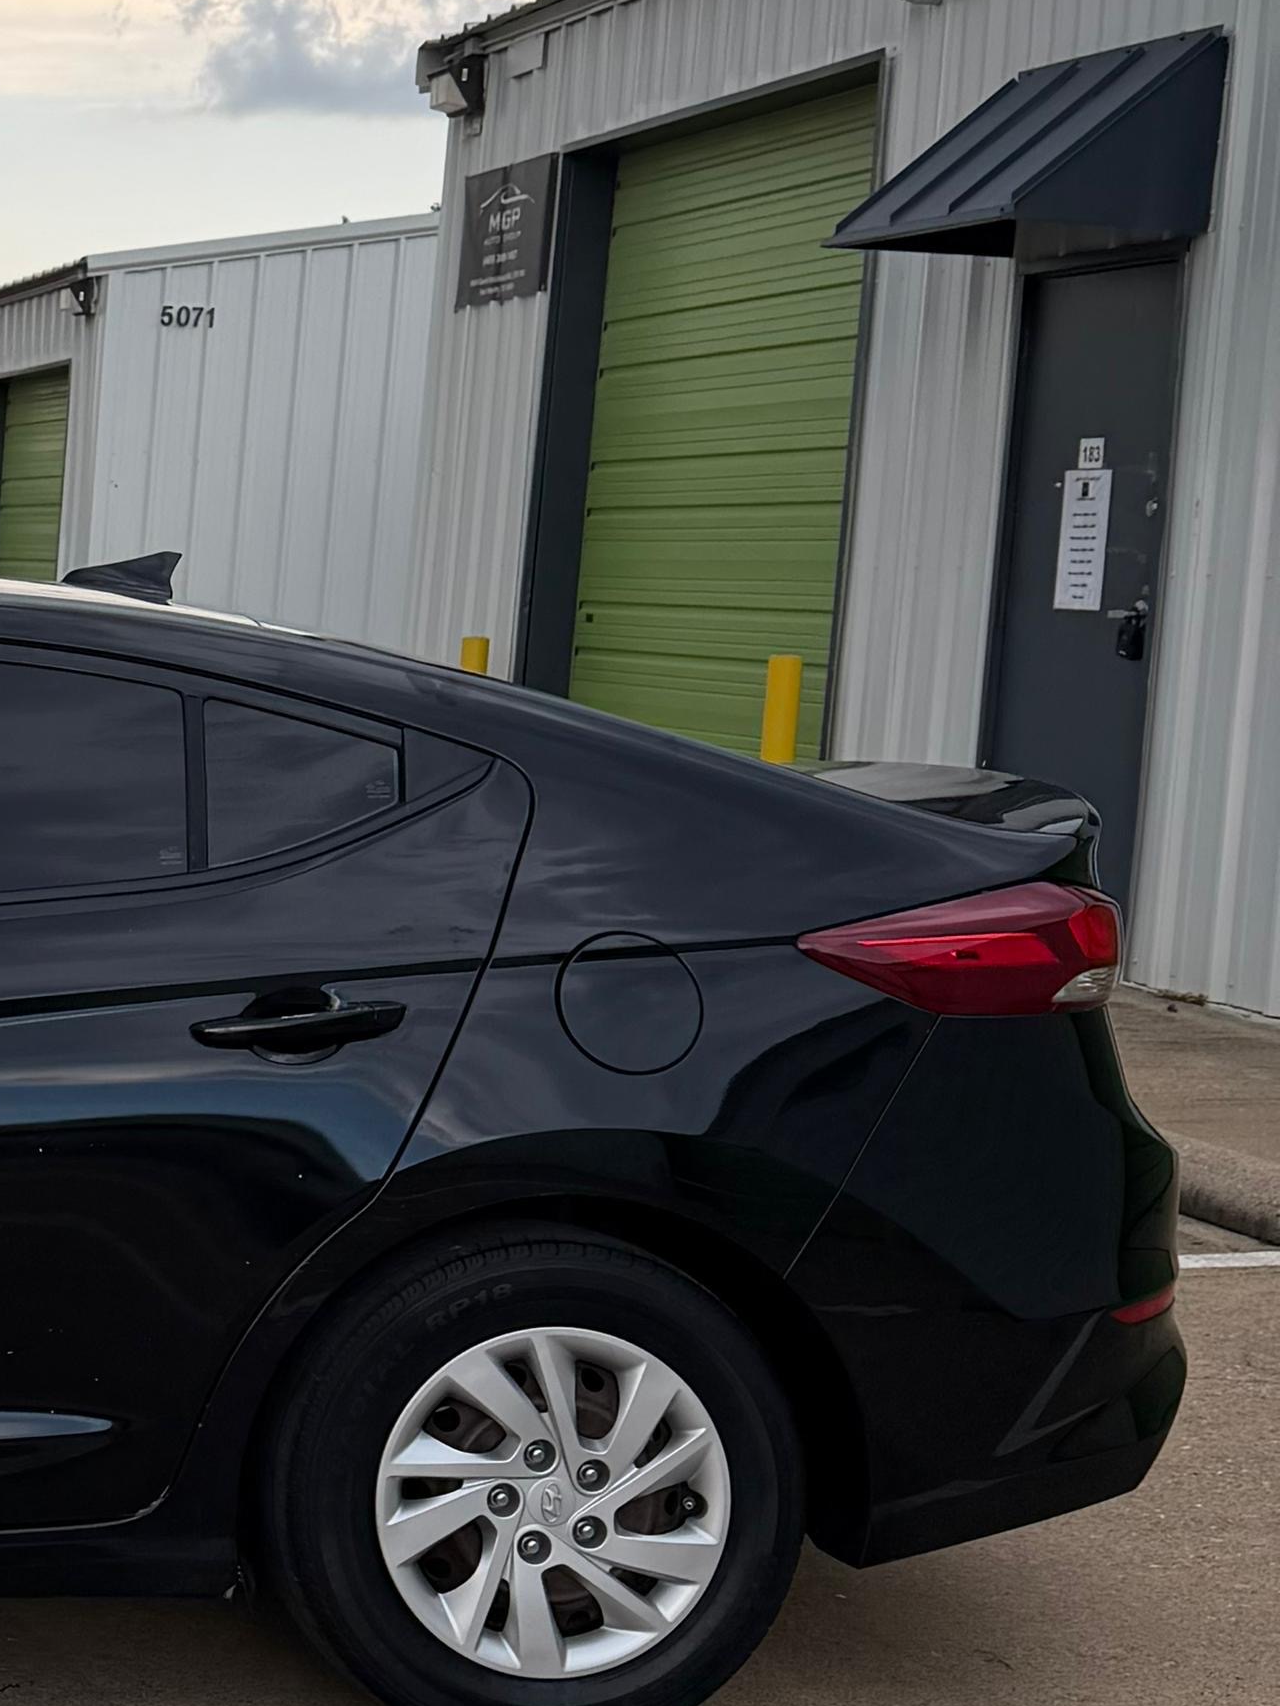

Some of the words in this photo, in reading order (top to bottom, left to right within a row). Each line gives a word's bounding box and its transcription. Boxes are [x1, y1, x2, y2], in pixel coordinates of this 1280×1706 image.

[488, 207, 521, 232] MGP
[160, 305, 215, 328] 5071
[1082, 445, 1102, 464] 183
